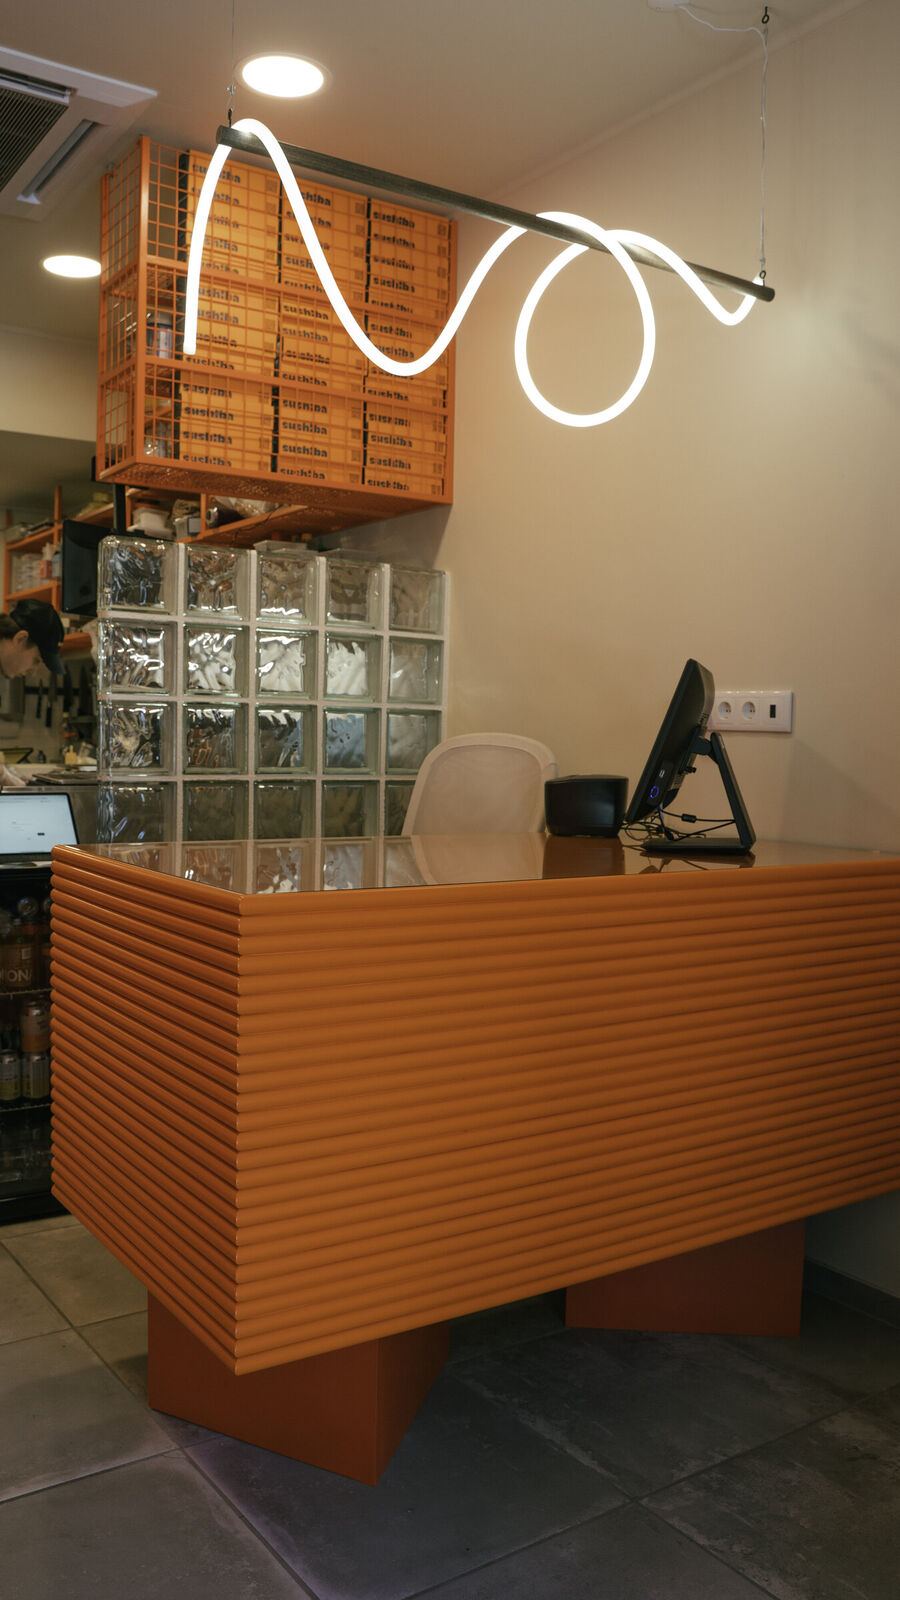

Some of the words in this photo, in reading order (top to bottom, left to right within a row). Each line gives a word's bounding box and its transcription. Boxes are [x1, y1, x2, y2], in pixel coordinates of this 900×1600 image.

[198, 287, 240, 302] ushiba
[197, 309, 240, 324] ushiba
[283, 305, 329, 320] sushiba
[282, 328, 329, 342] sushiba
[378, 345, 415, 358] ushiba
[282, 373, 328, 387] sushiba
[282, 400, 328, 414] sushiba
[282, 422, 328, 436] sushiba
[282, 445, 328, 458] sushiba
